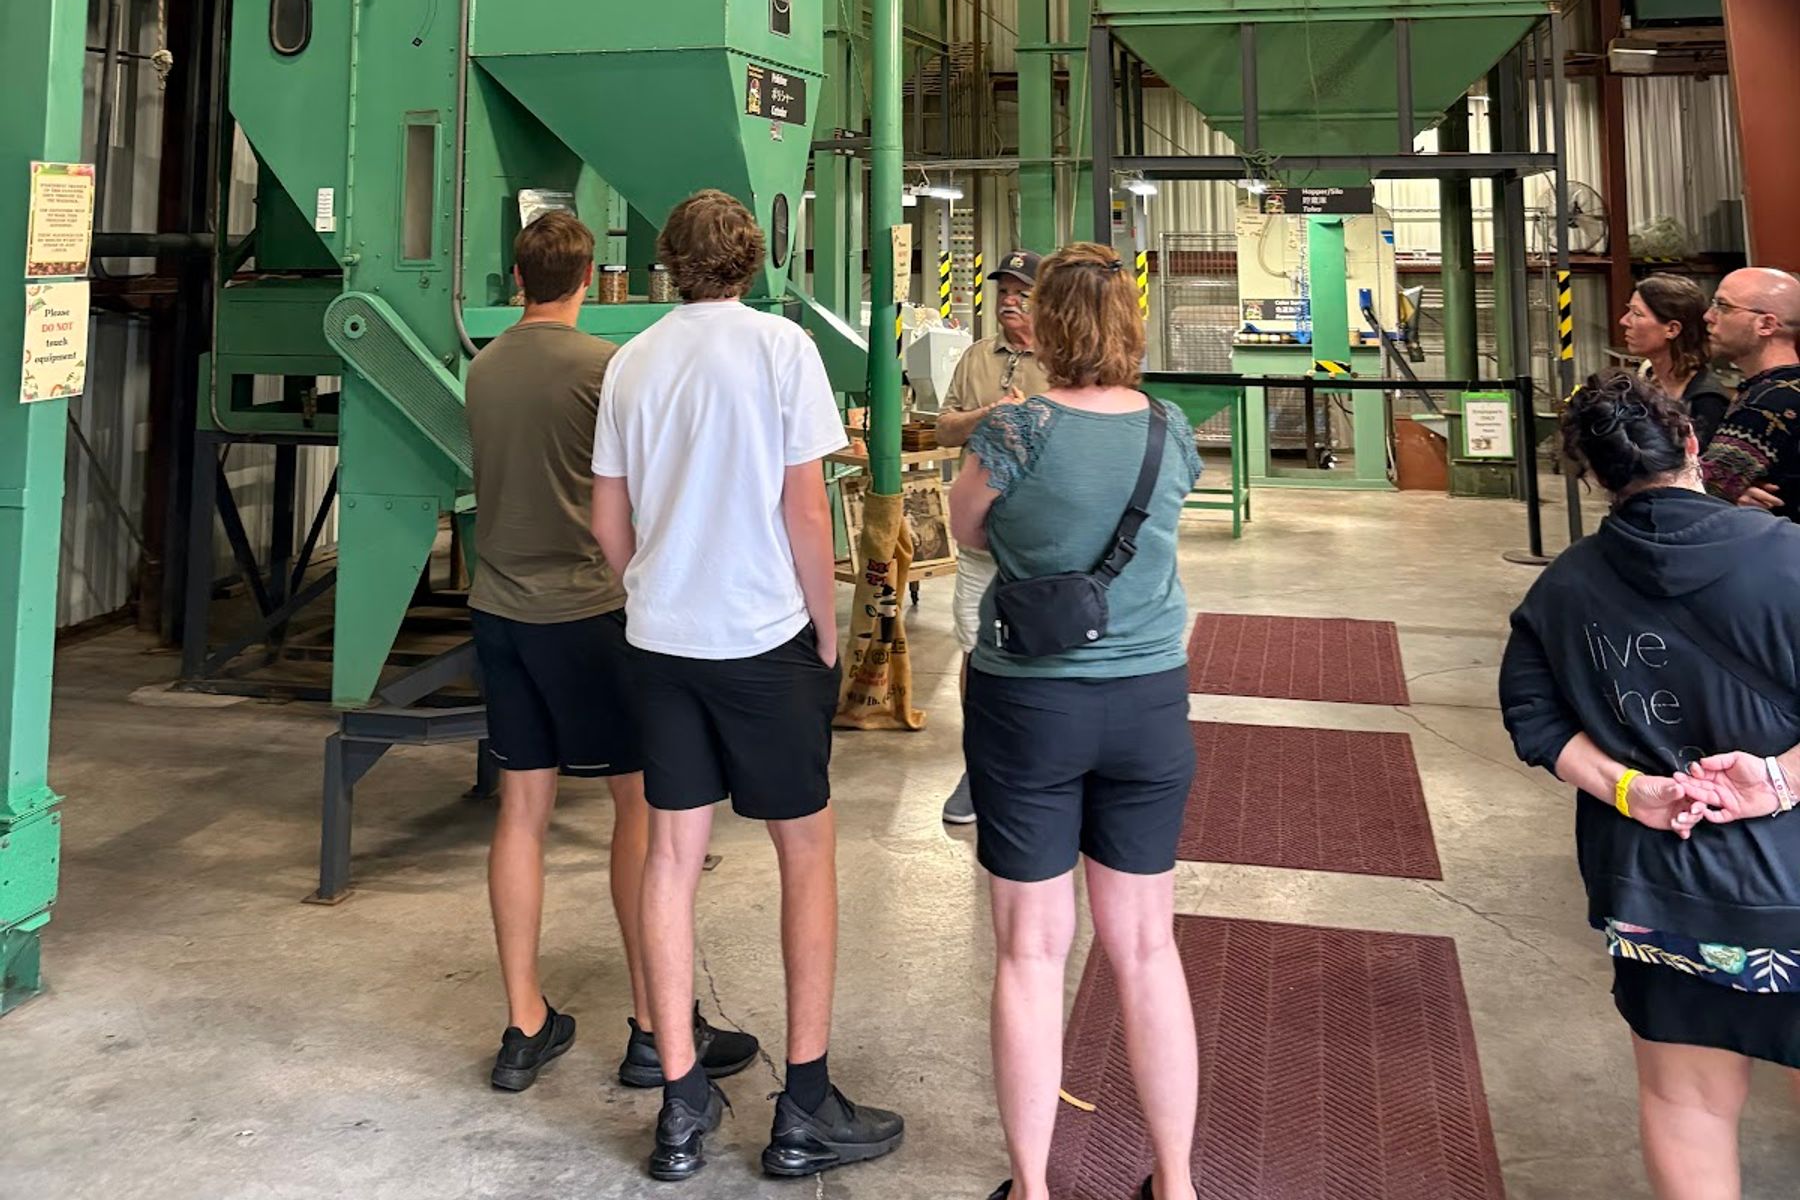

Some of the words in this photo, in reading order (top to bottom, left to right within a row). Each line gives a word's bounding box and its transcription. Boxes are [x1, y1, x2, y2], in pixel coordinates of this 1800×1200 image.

[1301, 188, 1344, 196] Hopper/Silo
[44, 308, 70, 318] Please
[41, 323, 54, 333] DO
[56, 321, 73, 332] NOT
[46, 336, 68, 347] touch
[34, 351, 77, 364] equipment
[1584, 622, 1668, 670] live
[1604, 678, 1682, 726] the
